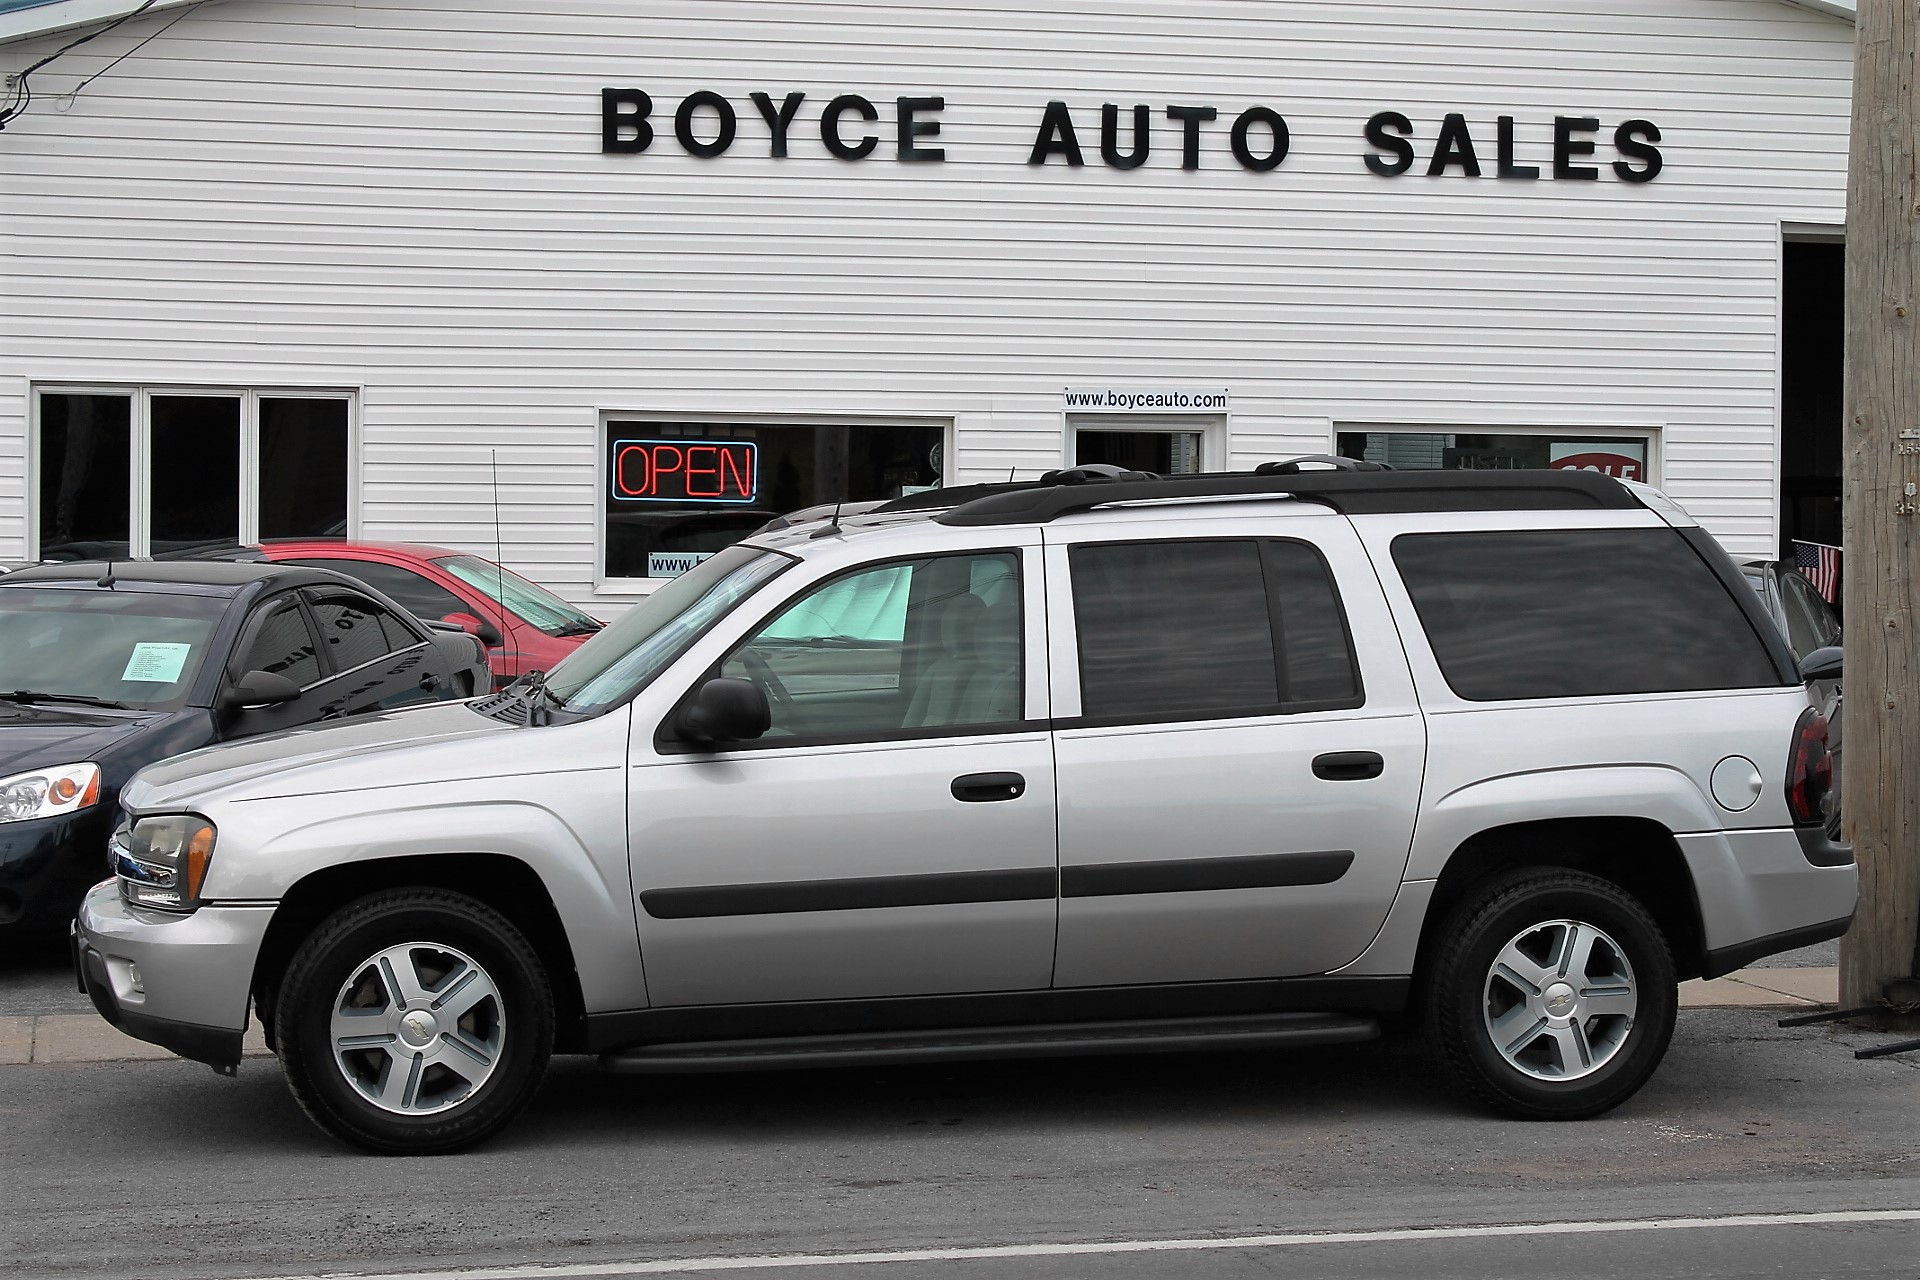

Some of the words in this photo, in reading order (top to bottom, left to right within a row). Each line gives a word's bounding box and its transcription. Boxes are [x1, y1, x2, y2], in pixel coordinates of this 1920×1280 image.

[601, 87, 945, 162] BOYCE
[1028, 100, 1290, 171] AUTO
[1363, 111, 1663, 183] SALES
[1066, 390, 1227, 409] www.boyceauto.com
[618, 445, 752, 497] OPEN
[1896, 503, 1920, 515] 35
